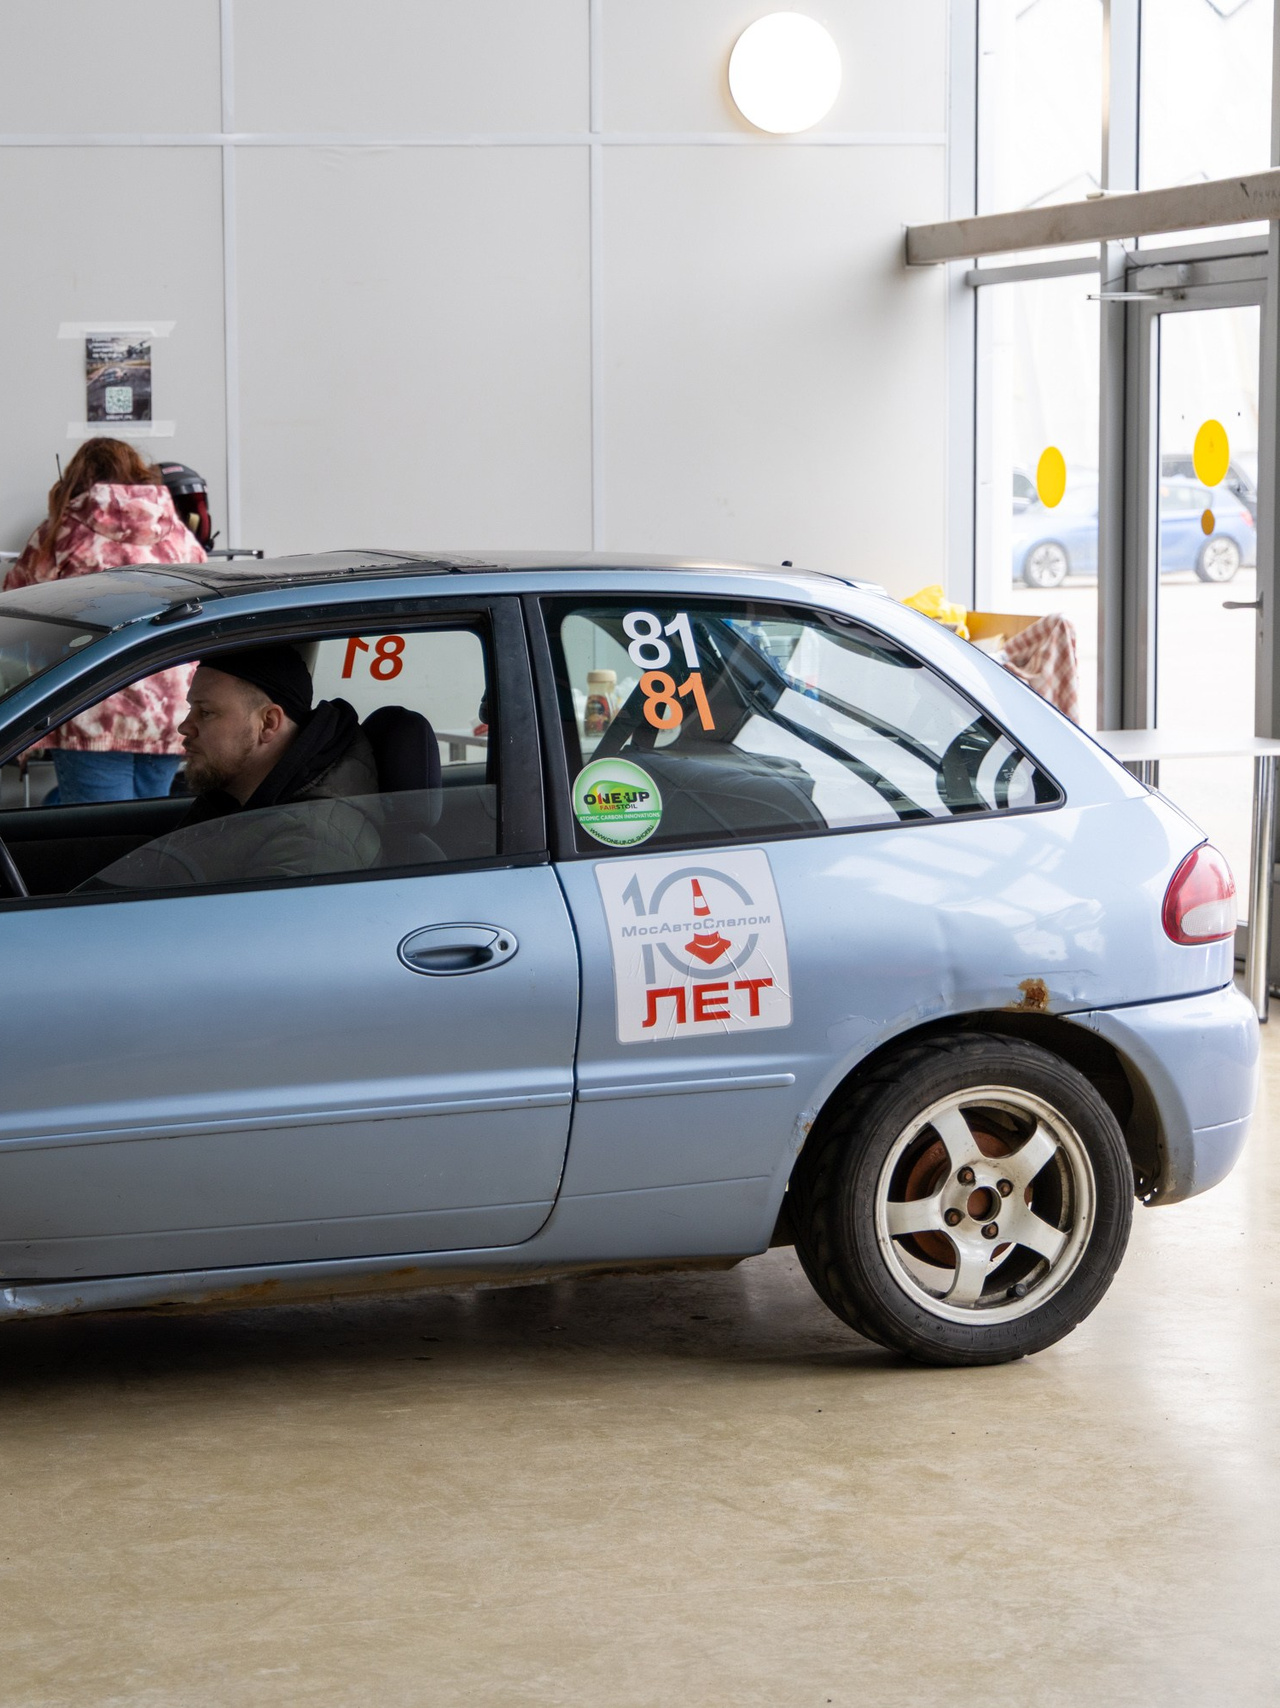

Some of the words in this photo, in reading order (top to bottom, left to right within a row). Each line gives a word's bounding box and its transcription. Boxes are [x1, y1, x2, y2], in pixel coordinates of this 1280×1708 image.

[622, 611, 700, 670] 81
[639, 670, 716, 731] 81
[600, 813, 624, 821] CARBON
[624, 812, 660, 820] INNOVATIONS
[621, 915, 771, 938] МосАвтоСлалом
[642, 977, 773, 1028] ЛЕТ
